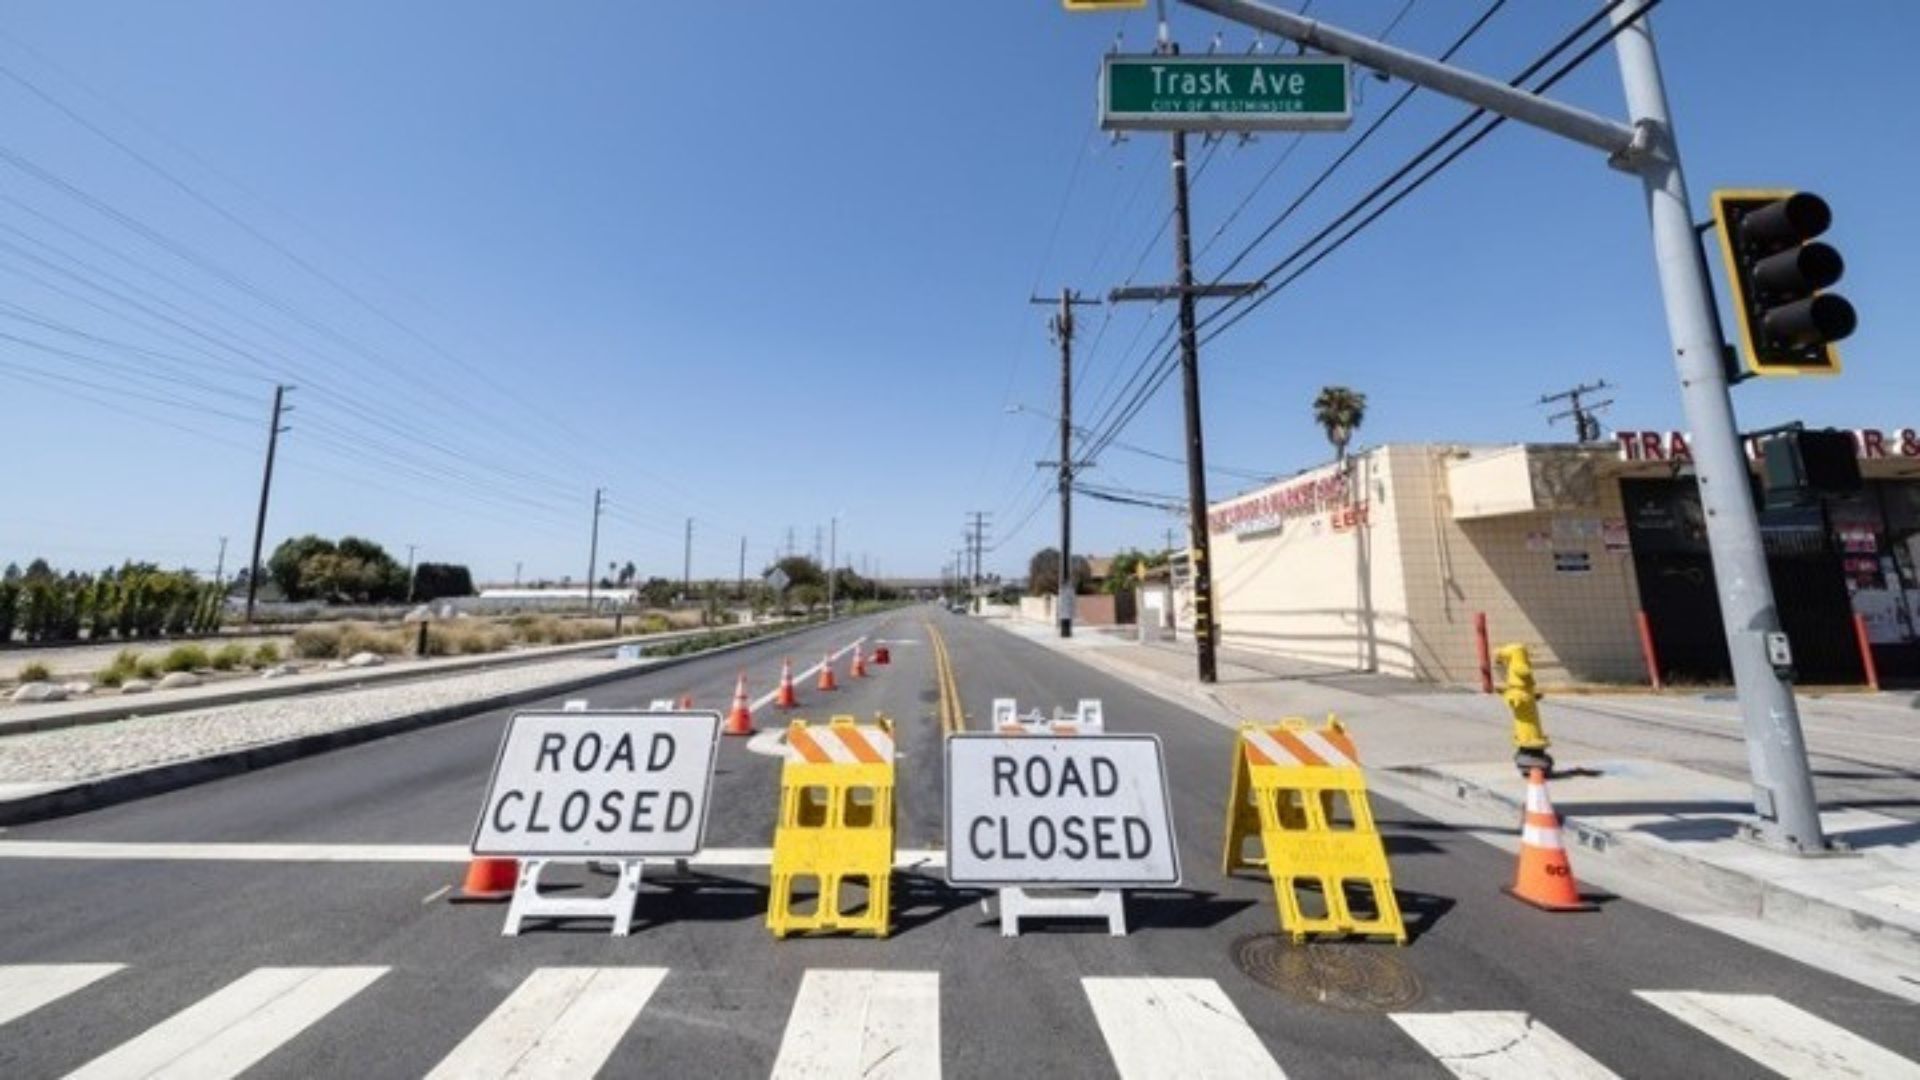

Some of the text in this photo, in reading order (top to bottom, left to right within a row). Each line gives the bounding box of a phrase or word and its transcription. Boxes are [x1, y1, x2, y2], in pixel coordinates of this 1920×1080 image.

[1152, 66, 1305, 94] Trask Ave
[1152, 100, 1182, 112] CITY
[1187, 100, 1203, 112] OF
[1616, 431, 1694, 461] TRA
[535, 731, 676, 772] ROAD
[992, 755, 1119, 798] ROAD
[493, 789, 694, 833] CLOSED
[969, 815, 1152, 860] CLOSED
